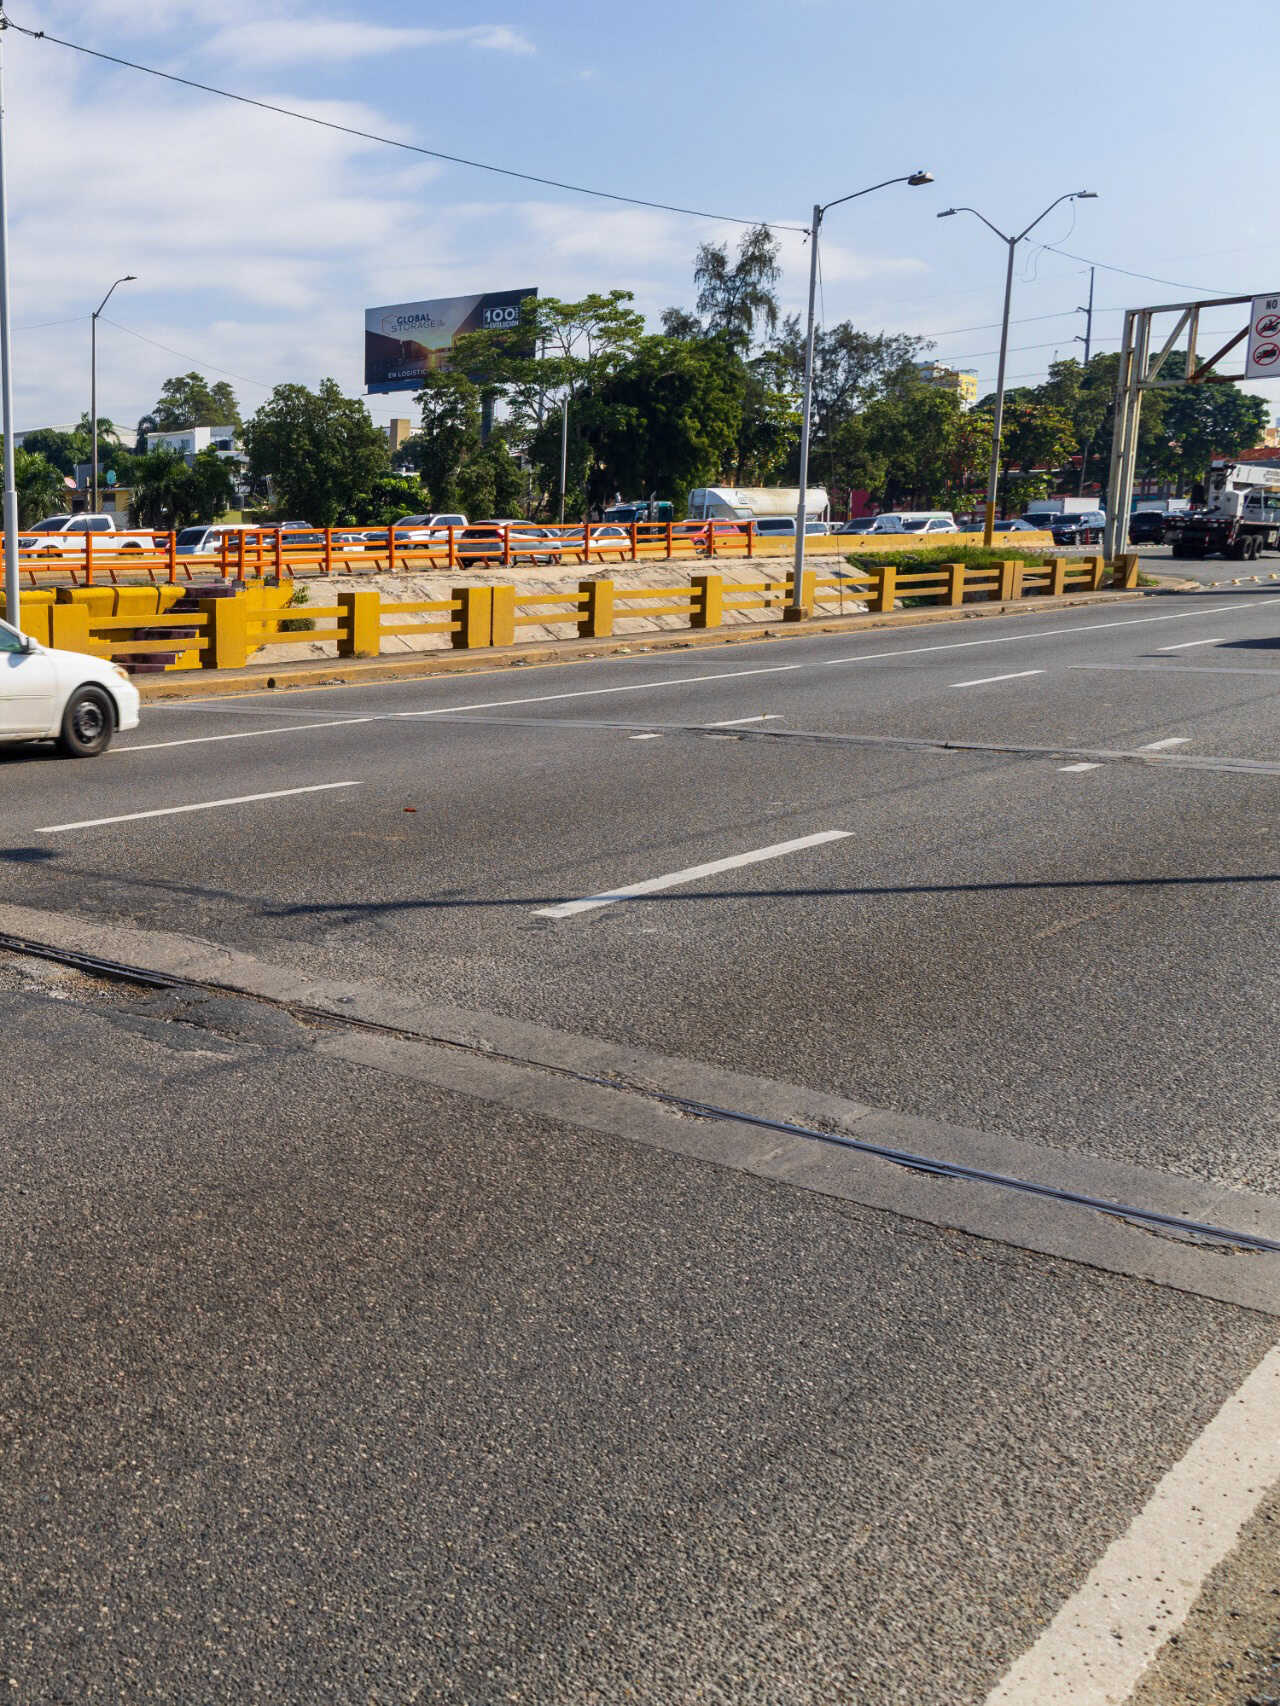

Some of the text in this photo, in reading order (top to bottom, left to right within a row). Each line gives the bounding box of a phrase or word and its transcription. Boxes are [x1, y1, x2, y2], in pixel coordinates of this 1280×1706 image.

[396, 313, 431, 324] GLOBAL
[485, 308, 516, 322] 100
[391, 320, 437, 333] STORAGE
